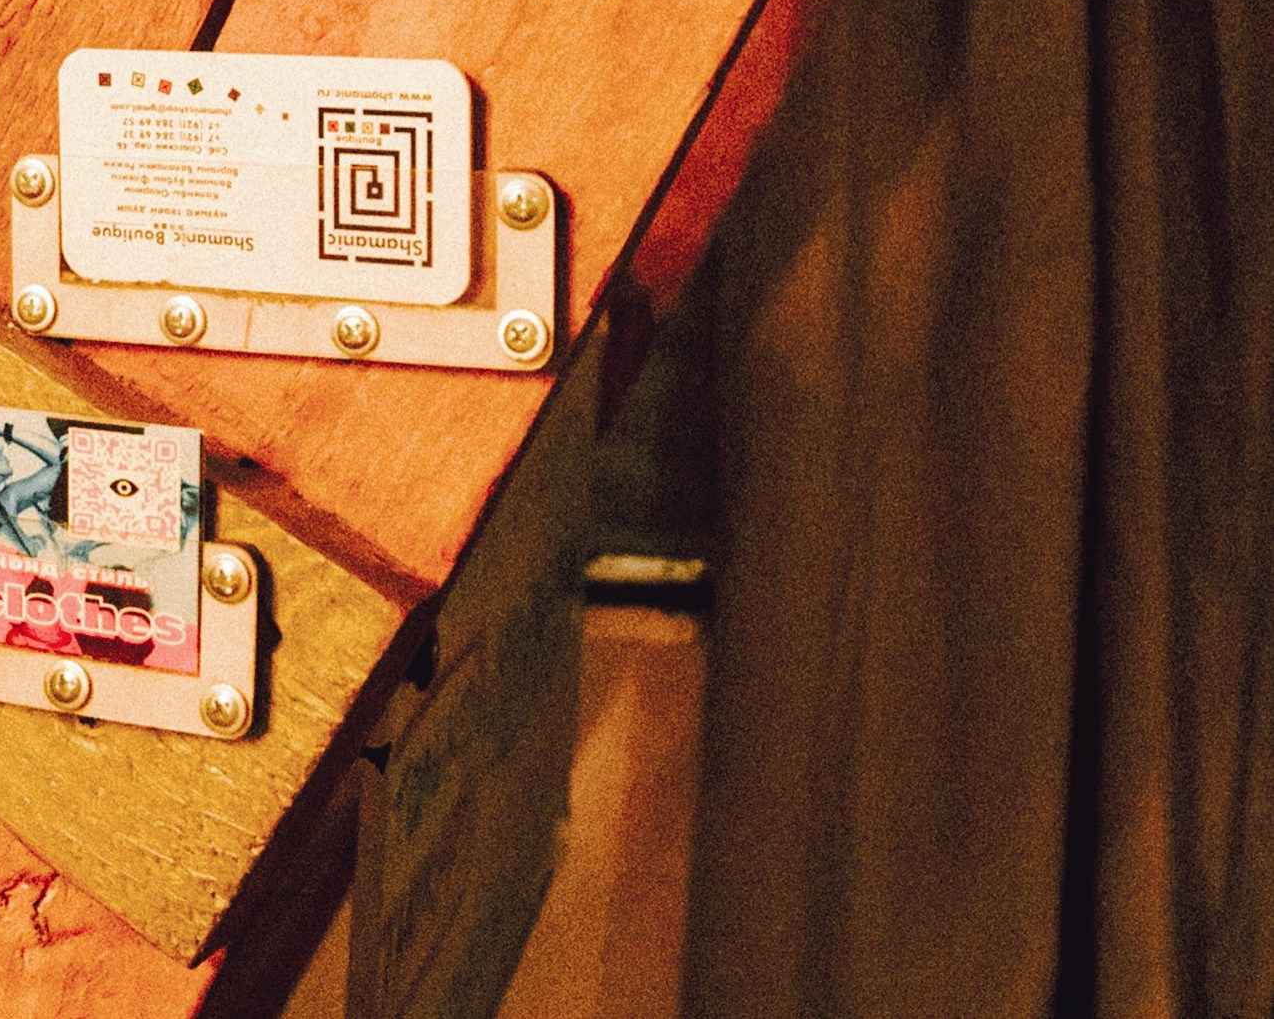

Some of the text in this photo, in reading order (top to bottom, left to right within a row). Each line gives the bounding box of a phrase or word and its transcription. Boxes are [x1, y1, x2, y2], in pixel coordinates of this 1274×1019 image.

[317, 88, 433, 104] www.shamanic.ru
[335, 135, 383, 147] Boutique
[91, 224, 255, 252] Shamanic Boutique
[327, 233, 423, 257] Shamanic
